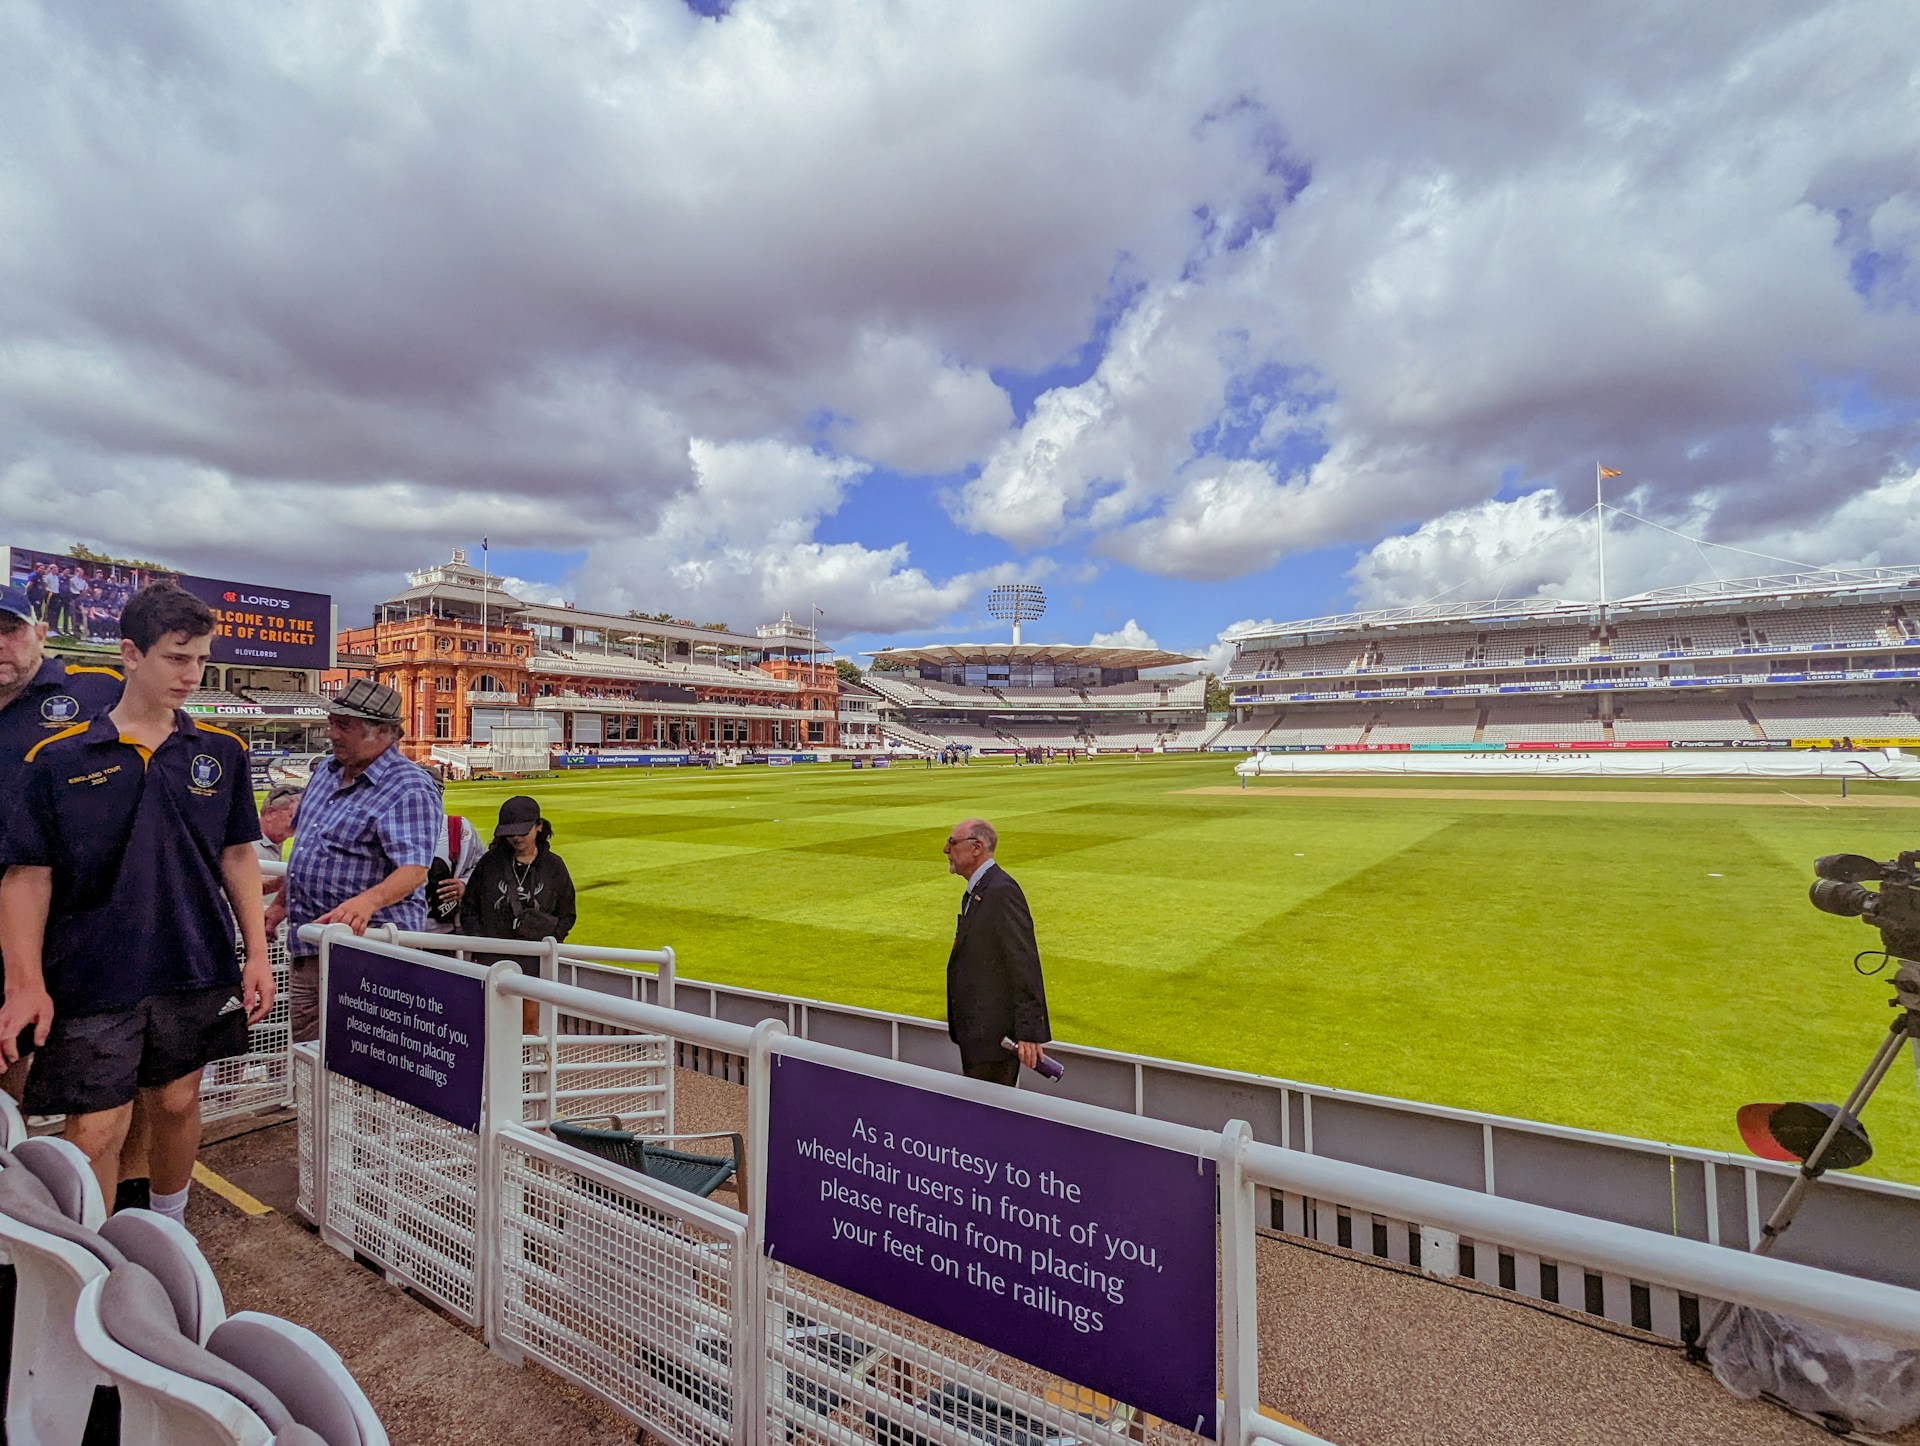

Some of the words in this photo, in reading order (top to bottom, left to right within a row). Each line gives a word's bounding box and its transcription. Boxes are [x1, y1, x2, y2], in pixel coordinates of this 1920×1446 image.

[209, 608, 263, 626] LCOME
[267, 616, 285, 629] TO
[289, 618, 313, 632] THE
[240, 595, 291, 609] LORD'S
[235, 648, 278, 658] #LOVELORDS
[237, 626, 255, 639] OF
[260, 628, 315, 645] CRICKET
[217, 706, 265, 715] COUNTS.
[68, 771, 102, 784] ENGLAND
[360, 977, 370, 992] As
[372, 984, 377, 994] a
[379, 985, 414, 1009] courtesy
[416, 995, 426, 1009] to
[428, 997, 443, 1014] the
[338, 993, 378, 1016] wheelchair
[380, 1006, 401, 1024] users
[403, 1012, 412, 1027] in
[414, 1014, 435, 1035] front
[437, 1024, 448, 1039] of
[449, 1029, 469, 1048] you,
[346, 1016, 371, 1035] please
[372, 1026, 399, 1044] refrain
[401, 1033, 421, 1053] from
[423, 1042, 456, 1069] placing
[351, 1039, 368, 1053] your
[370, 1043, 386, 1062] feet
[387, 1053, 398, 1067] on
[400, 1055, 414, 1073] the
[416, 1063, 448, 1088] railings
[852, 1117, 877, 1144] As
[883, 1130, 895, 1149] a
[901, 1134, 998, 1184] courtesy
[1005, 1162, 1031, 1188] to
[1039, 1170, 1081, 1203] the
[797, 1138, 900, 1185] wheelchair
[907, 1171, 964, 1206] users
[971, 1188, 992, 1215] in
[1000, 1194, 1062, 1238] front
[1070, 1222, 1098, 1248] of
[1105, 1233, 1163, 1273] you,
[820, 1177, 882, 1215] please
[889, 1202, 957, 1241] refrain
[965, 1221, 1022, 1263] from
[1031, 1248, 1125, 1305] placing
[832, 1217, 878, 1247] your
[883, 1230, 924, 1266] feet
[931, 1253, 959, 1279] on
[967, 1261, 1005, 1295] the
[1013, 1280, 1104, 1334] railings
